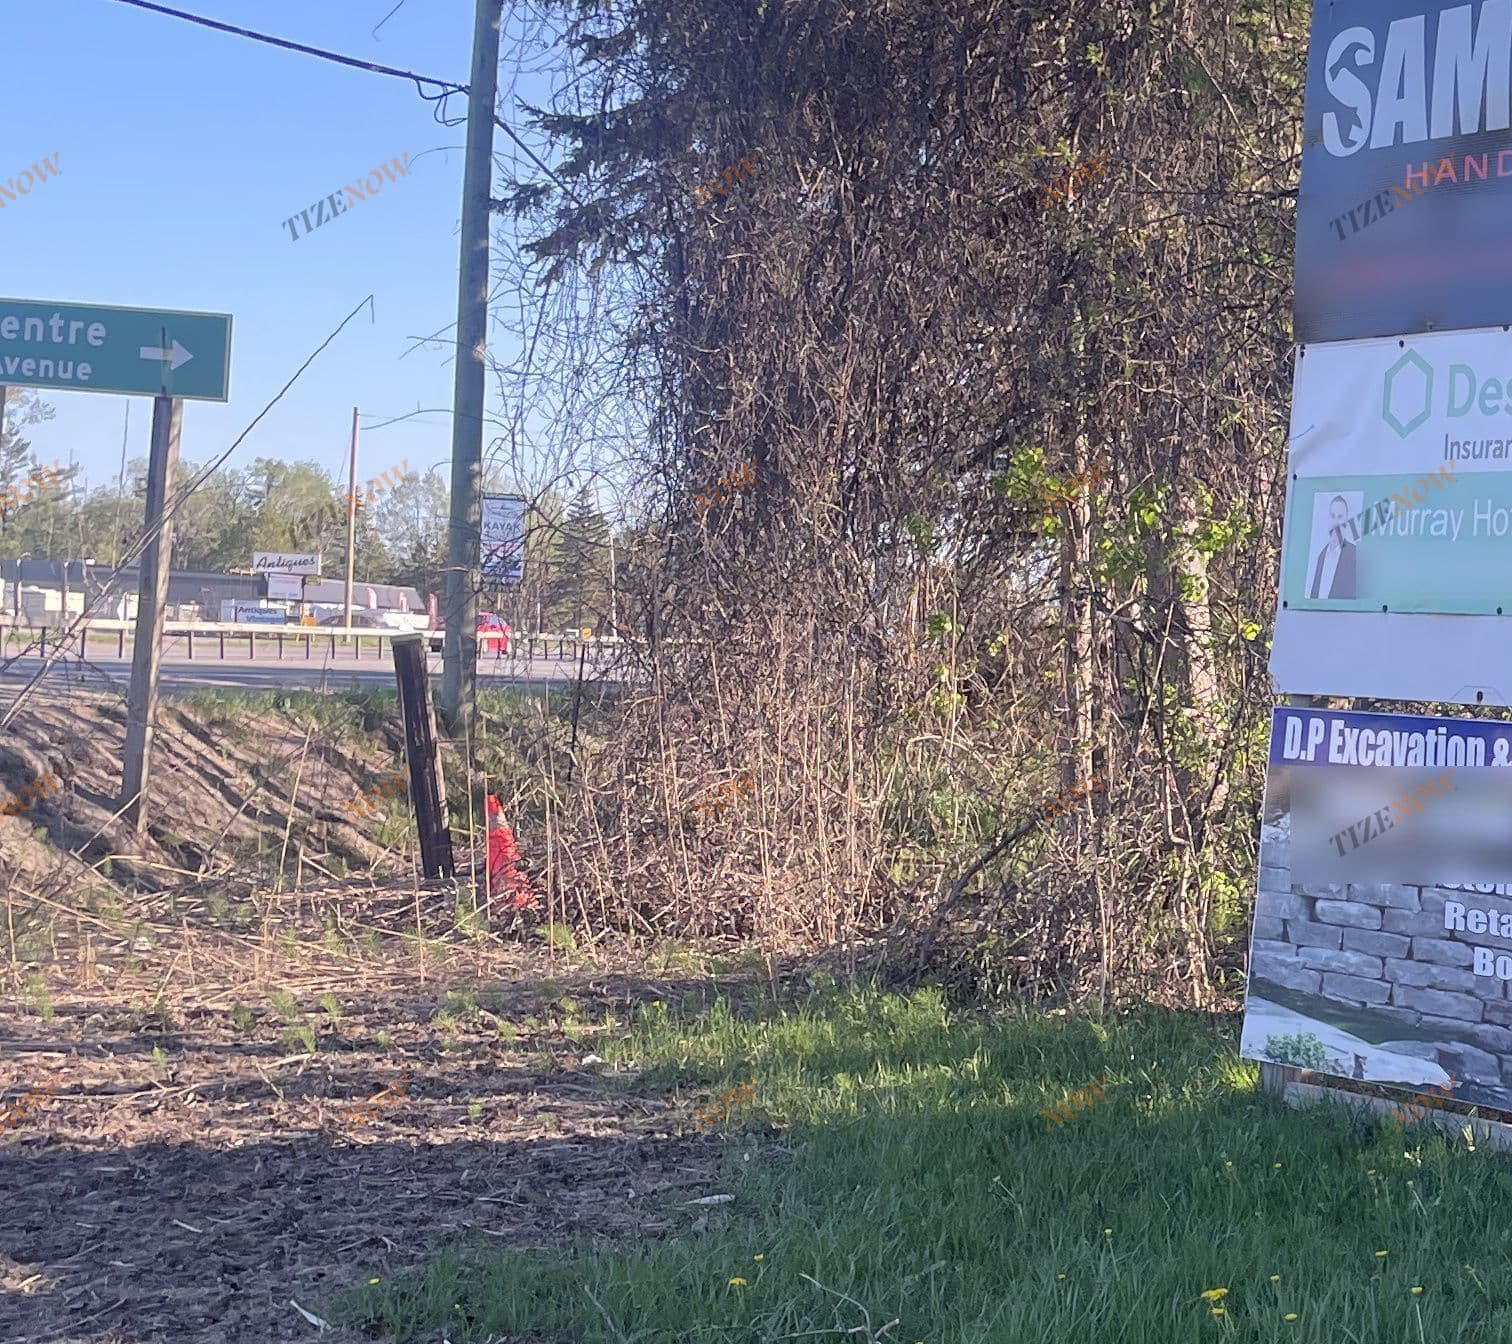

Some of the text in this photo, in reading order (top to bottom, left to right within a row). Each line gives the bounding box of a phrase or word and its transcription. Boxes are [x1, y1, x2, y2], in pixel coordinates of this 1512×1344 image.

[0, 356, 92, 380] venue
[1371, 499, 1464, 541] Murray
[256, 556, 316, 572] Antiques
[1328, 719, 1486, 767] Excavation
[1491, 738, 1512, 767] &
